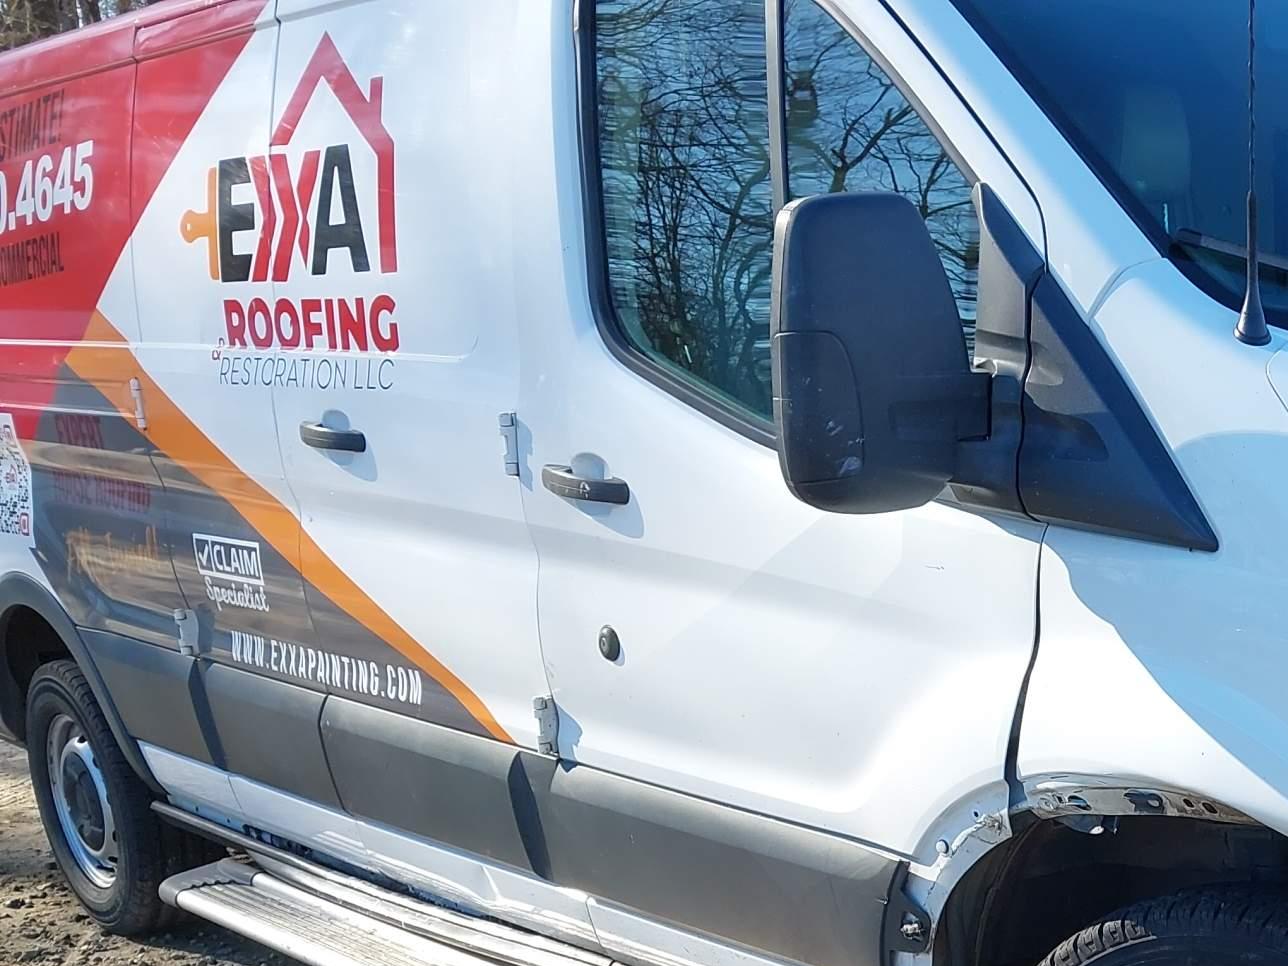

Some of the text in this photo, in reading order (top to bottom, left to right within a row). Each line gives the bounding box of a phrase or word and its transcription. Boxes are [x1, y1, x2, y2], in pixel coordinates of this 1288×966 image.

[223, 294, 400, 353] ROOFING
[218, 356, 348, 390] RESTORATION
[353, 358, 395, 391] LLC
[212, 545, 260, 578] CLAIM
[203, 576, 270, 613] Specialist
[230, 630, 423, 706] WWW.EXXAPAINTING.COM
